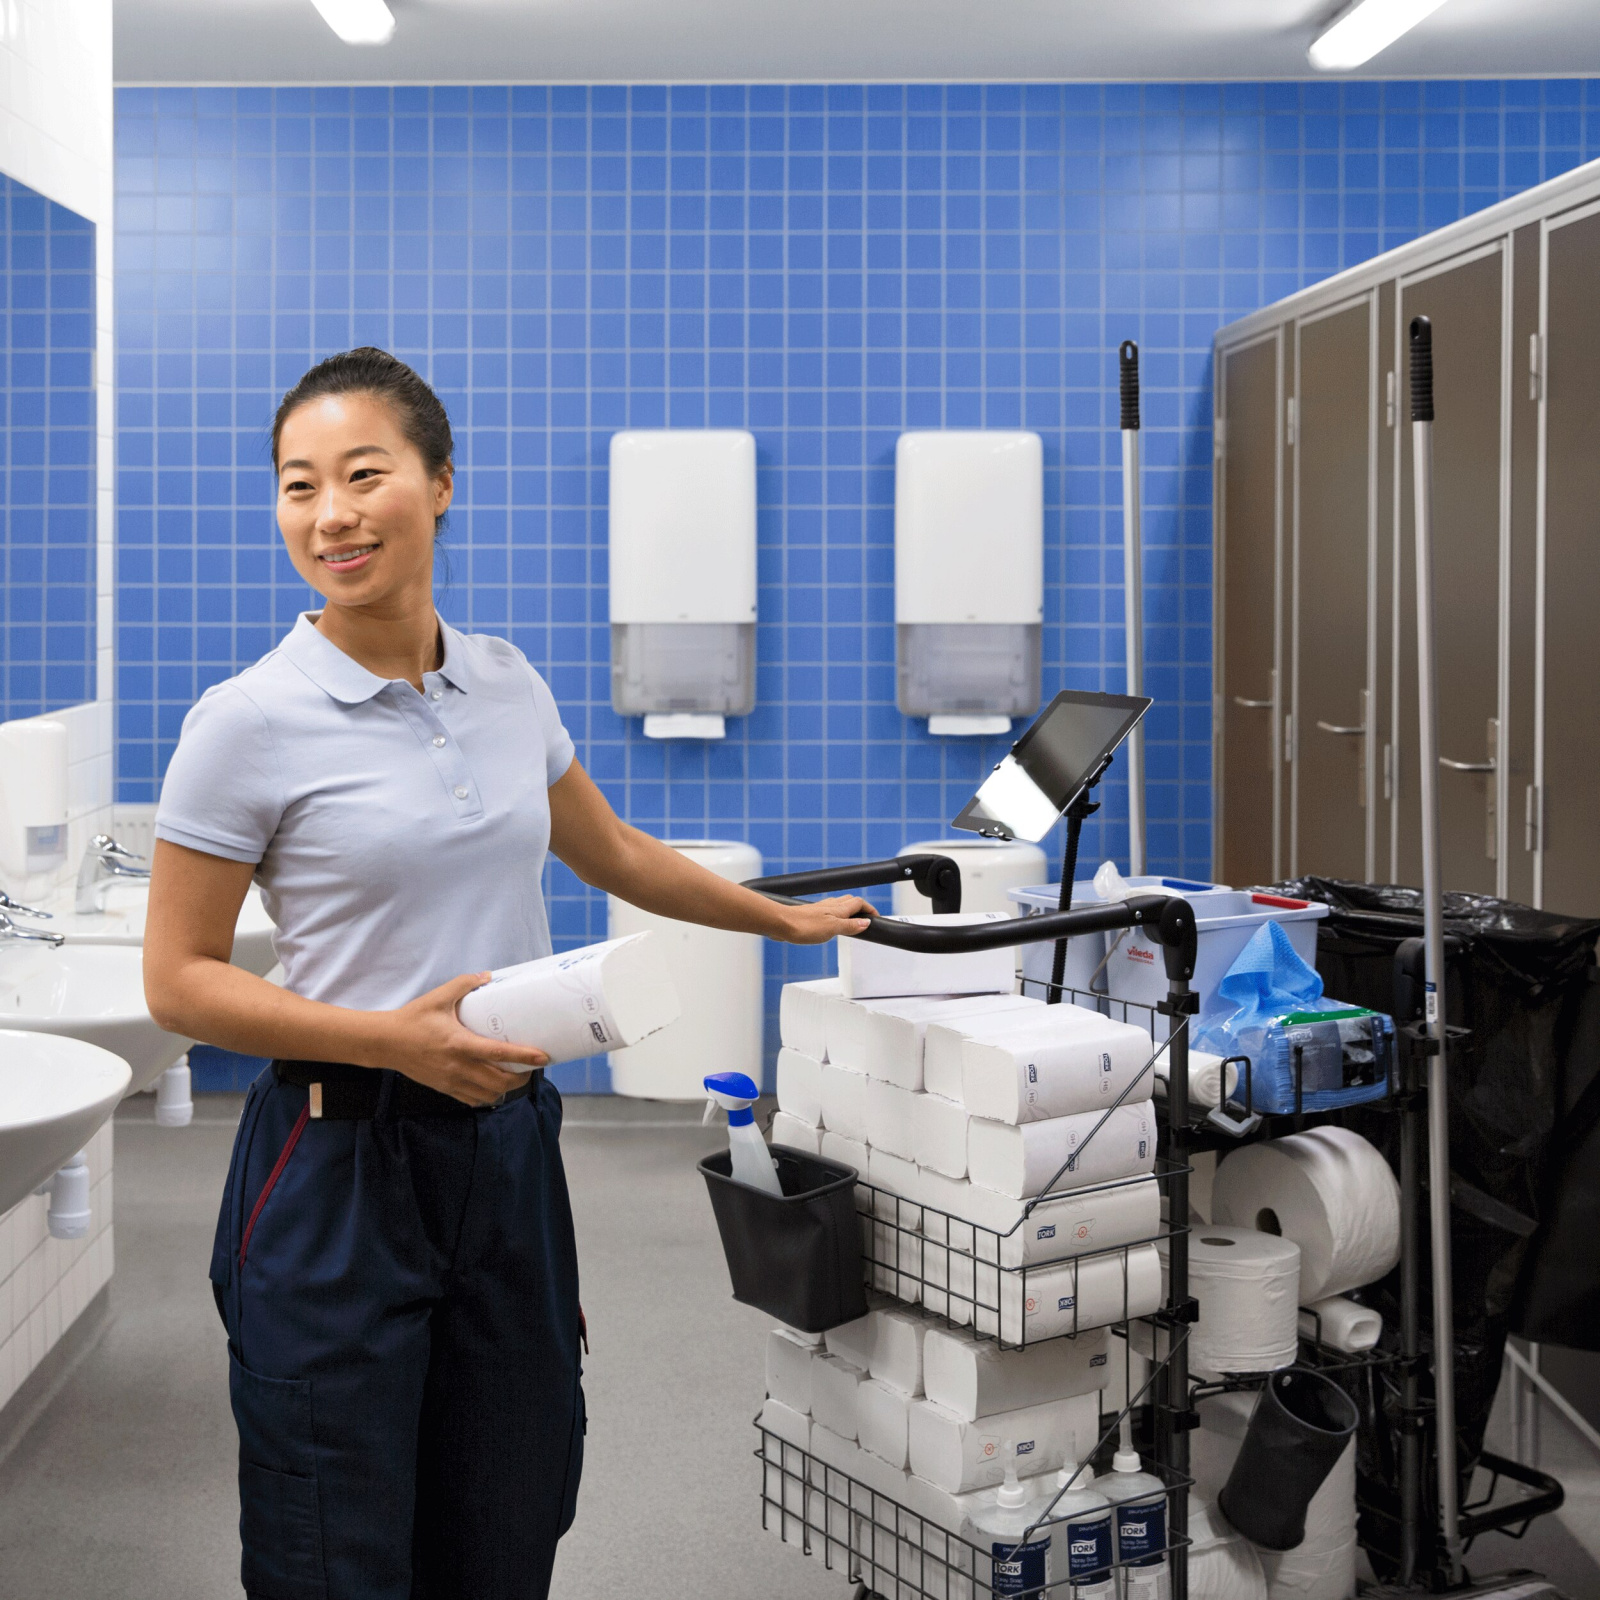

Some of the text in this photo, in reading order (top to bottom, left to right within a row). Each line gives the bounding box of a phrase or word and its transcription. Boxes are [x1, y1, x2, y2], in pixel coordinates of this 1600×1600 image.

[1127, 946, 1154, 960] vileda
[590, 1022, 607, 1043] TORK
[1291, 1032, 1312, 1041] TORK
[1103, 1053, 1111, 1072] TORK
[1028, 1064, 1037, 1083] TORK
[1037, 1228, 1056, 1240] TORK
[1090, 1356, 1107, 1367] TORK
[1017, 1442, 1034, 1453] TORK
[1121, 1526, 1145, 1535] TORK
[1072, 1544, 1095, 1553] TORK
[997, 1564, 1020, 1574] ORK
